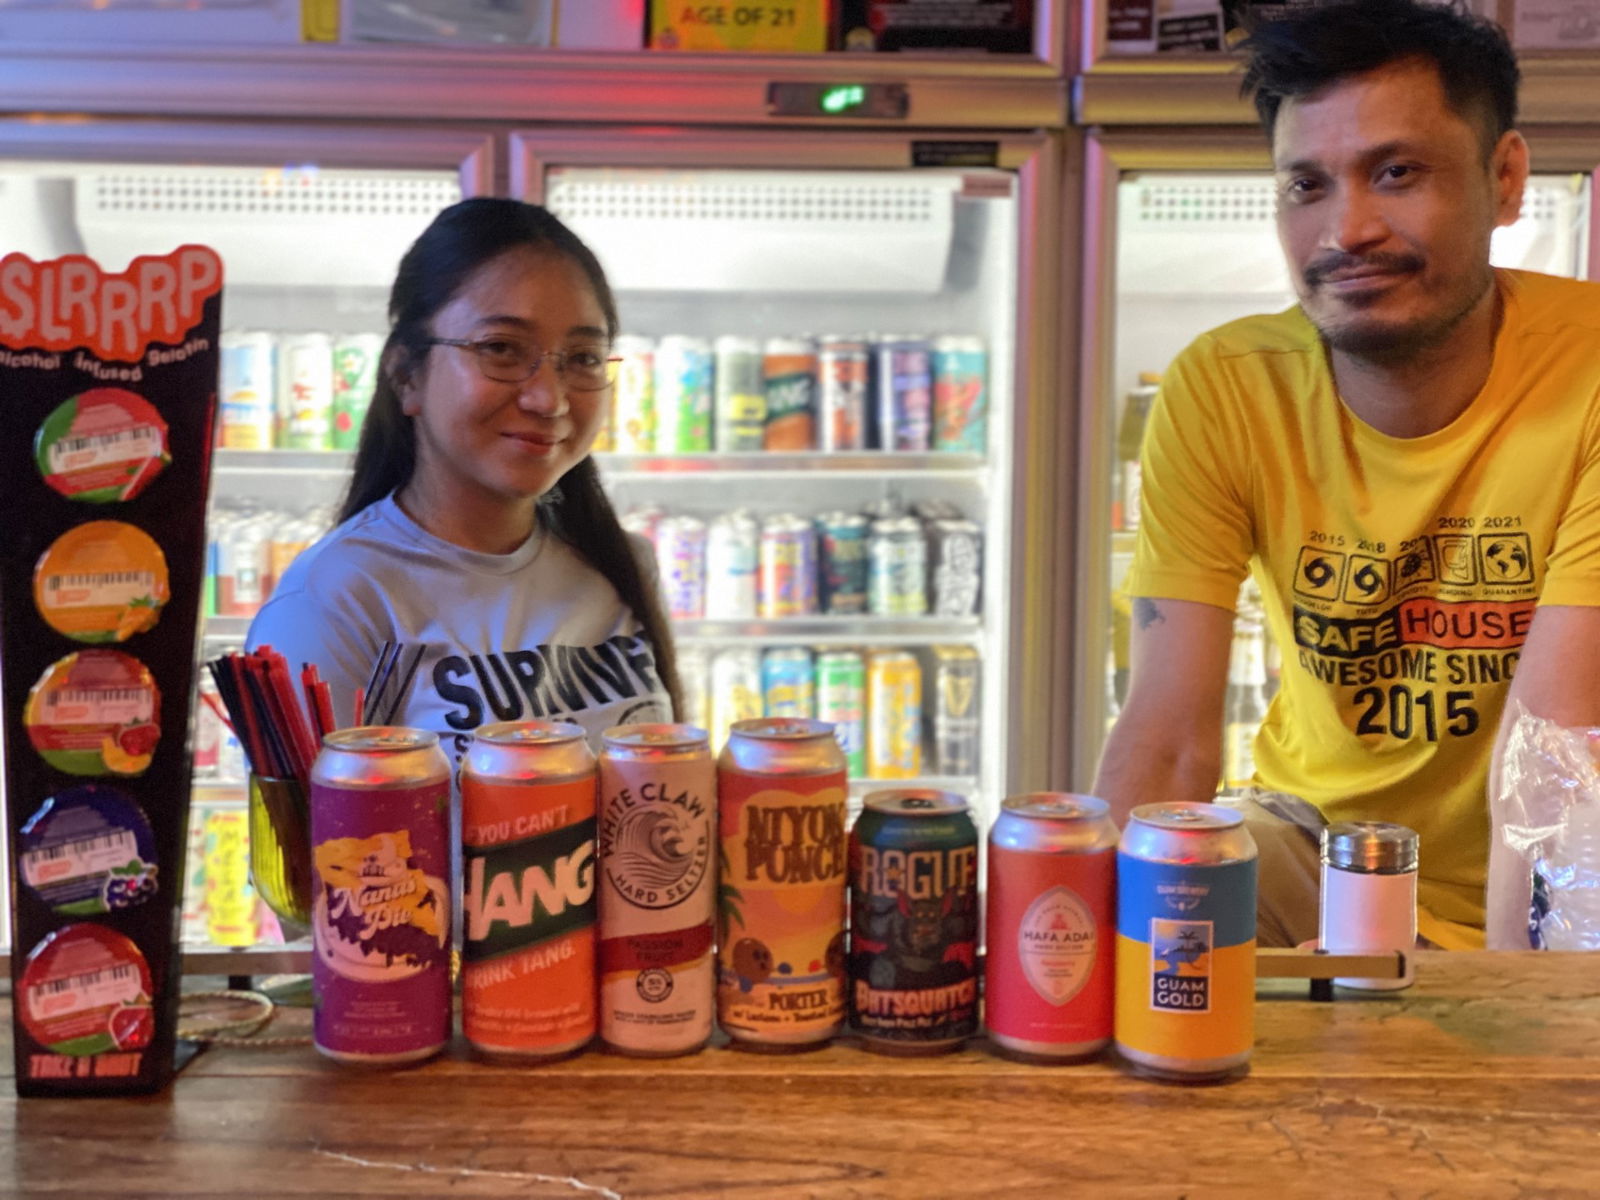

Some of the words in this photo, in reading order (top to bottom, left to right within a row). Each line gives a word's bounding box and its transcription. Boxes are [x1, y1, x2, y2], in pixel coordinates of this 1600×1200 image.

[680, 7, 726, 25] AGE
[733, 7, 763, 26] OF
[771, 8, 796, 26] 21
[0, 250, 216, 351] SLRRRP
[1310, 531, 1345, 546] 2015
[1439, 517, 1475, 528] 2020
[1484, 516, 1522, 528] 2021
[1297, 614, 1397, 652] SAFE
[1406, 608, 1532, 639] HOUSE
[1300, 650, 1437, 686] AWESOME
[1446, 653, 1520, 686] SINC
[1353, 684, 1479, 742] 2015
[478, 821, 510, 844] YOU
[515, 804, 568, 834] CAN'T
[600, 788, 635, 857] WHITE
[641, 783, 704, 818] CLAW
[616, 874, 658, 902] HARD
[1157, 978, 1204, 991] GUAM
[1157, 991, 1204, 1007] GOLD
